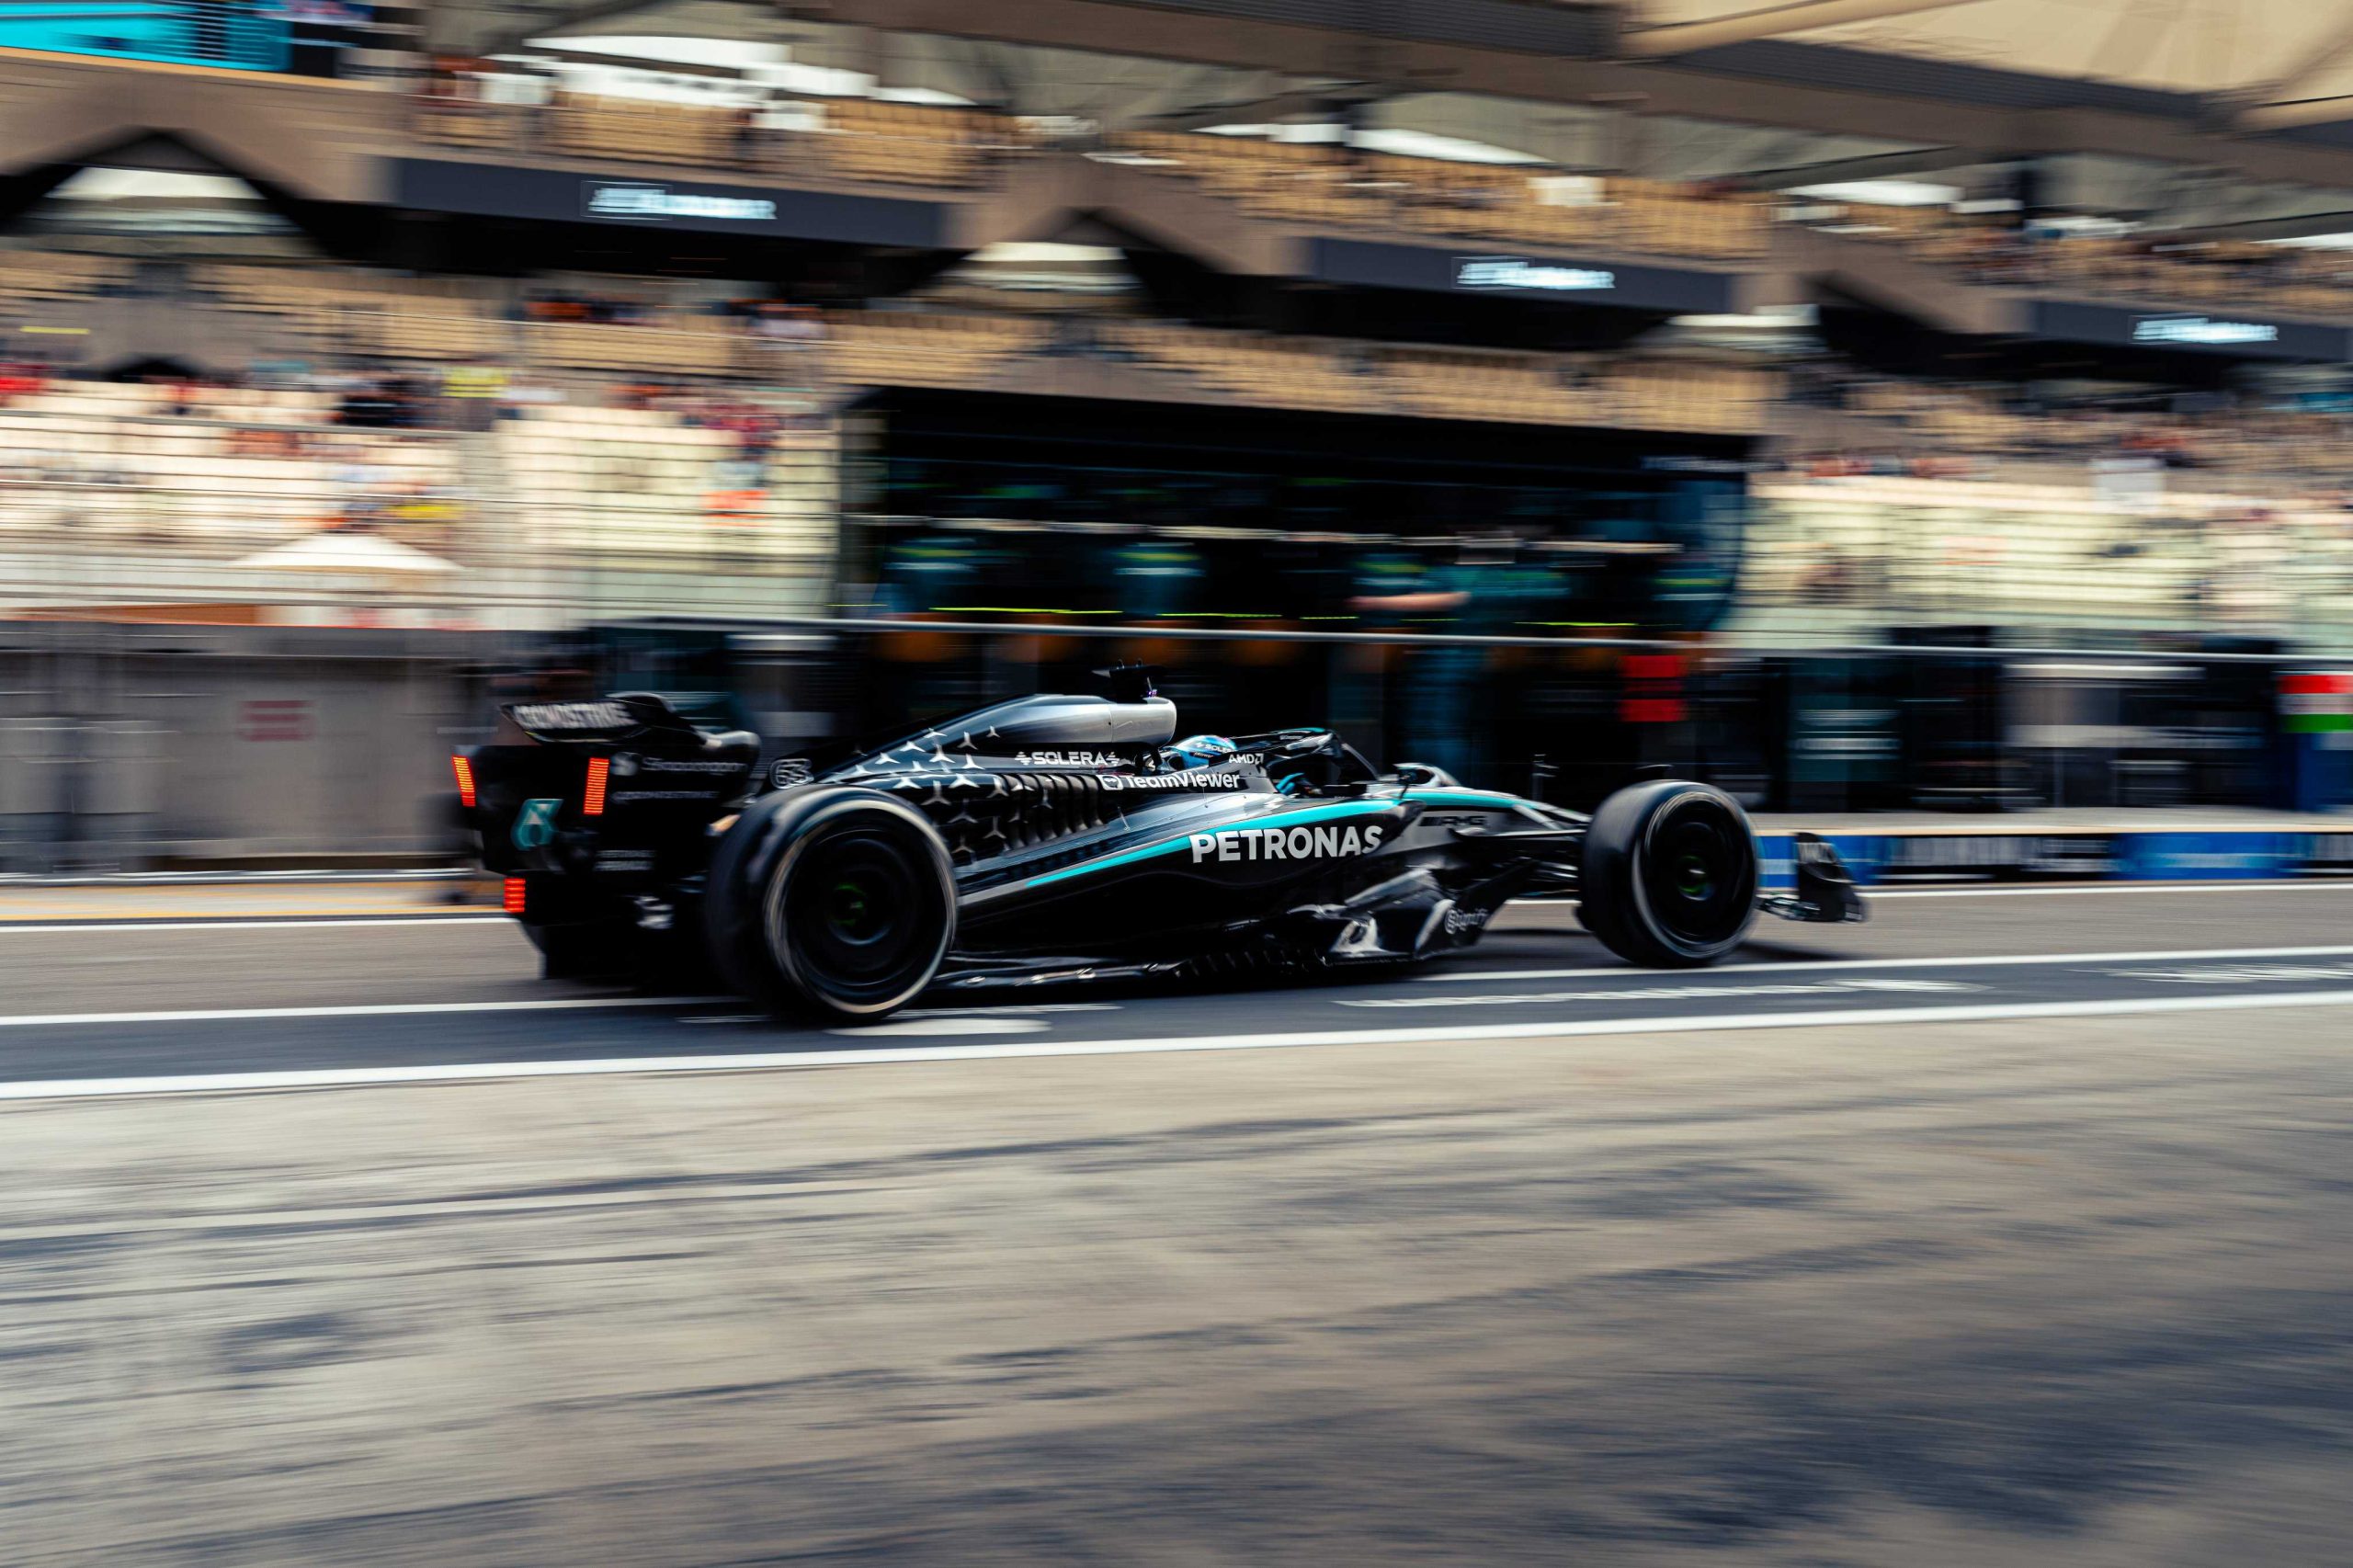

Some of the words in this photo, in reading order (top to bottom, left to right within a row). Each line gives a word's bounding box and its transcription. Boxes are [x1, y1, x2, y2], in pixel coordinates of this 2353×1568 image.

[1031, 752, 1109, 766] SOLERA
[1229, 754, 1254, 765] AMD
[770, 758, 815, 789] 63
[1127, 773, 1239, 788] TeamViewer
[1189, 825, 1383, 863] PETRONAS
